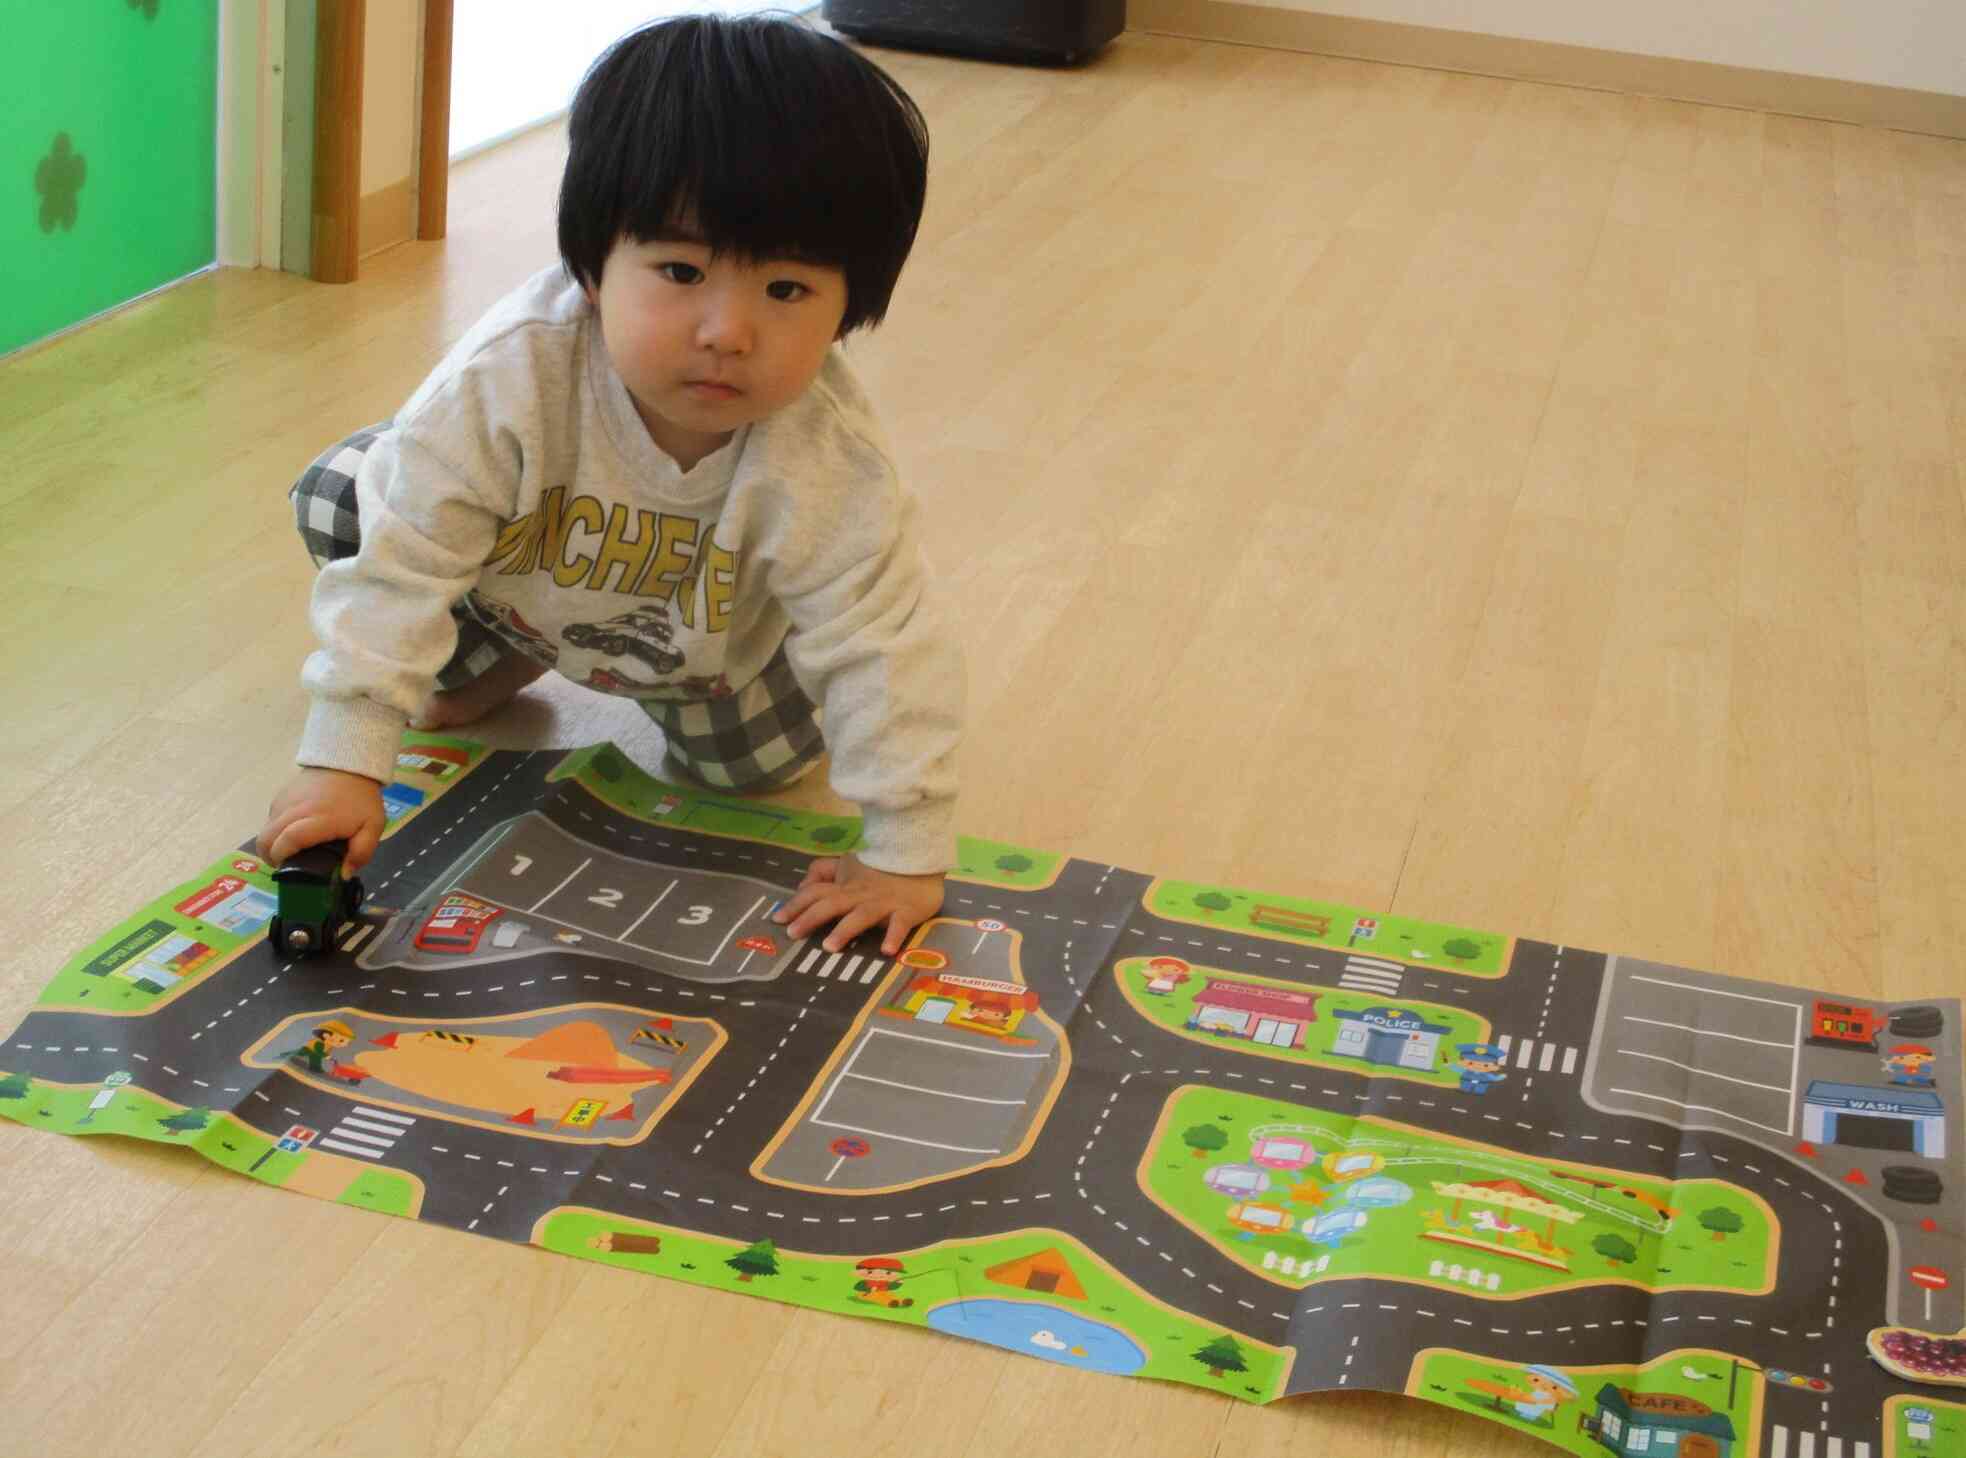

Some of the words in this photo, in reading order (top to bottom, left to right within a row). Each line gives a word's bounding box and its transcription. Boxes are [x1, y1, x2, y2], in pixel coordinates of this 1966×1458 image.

[509, 854, 534, 876] 1
[587, 887, 624, 909] 2
[676, 904, 714, 926] 3
[941, 974, 1026, 993] HAMBURGER
[1363, 1013, 1421, 1030] POLICE
[1848, 1099, 1900, 1113] WASH
[1628, 1395, 1689, 1412] CAFE
